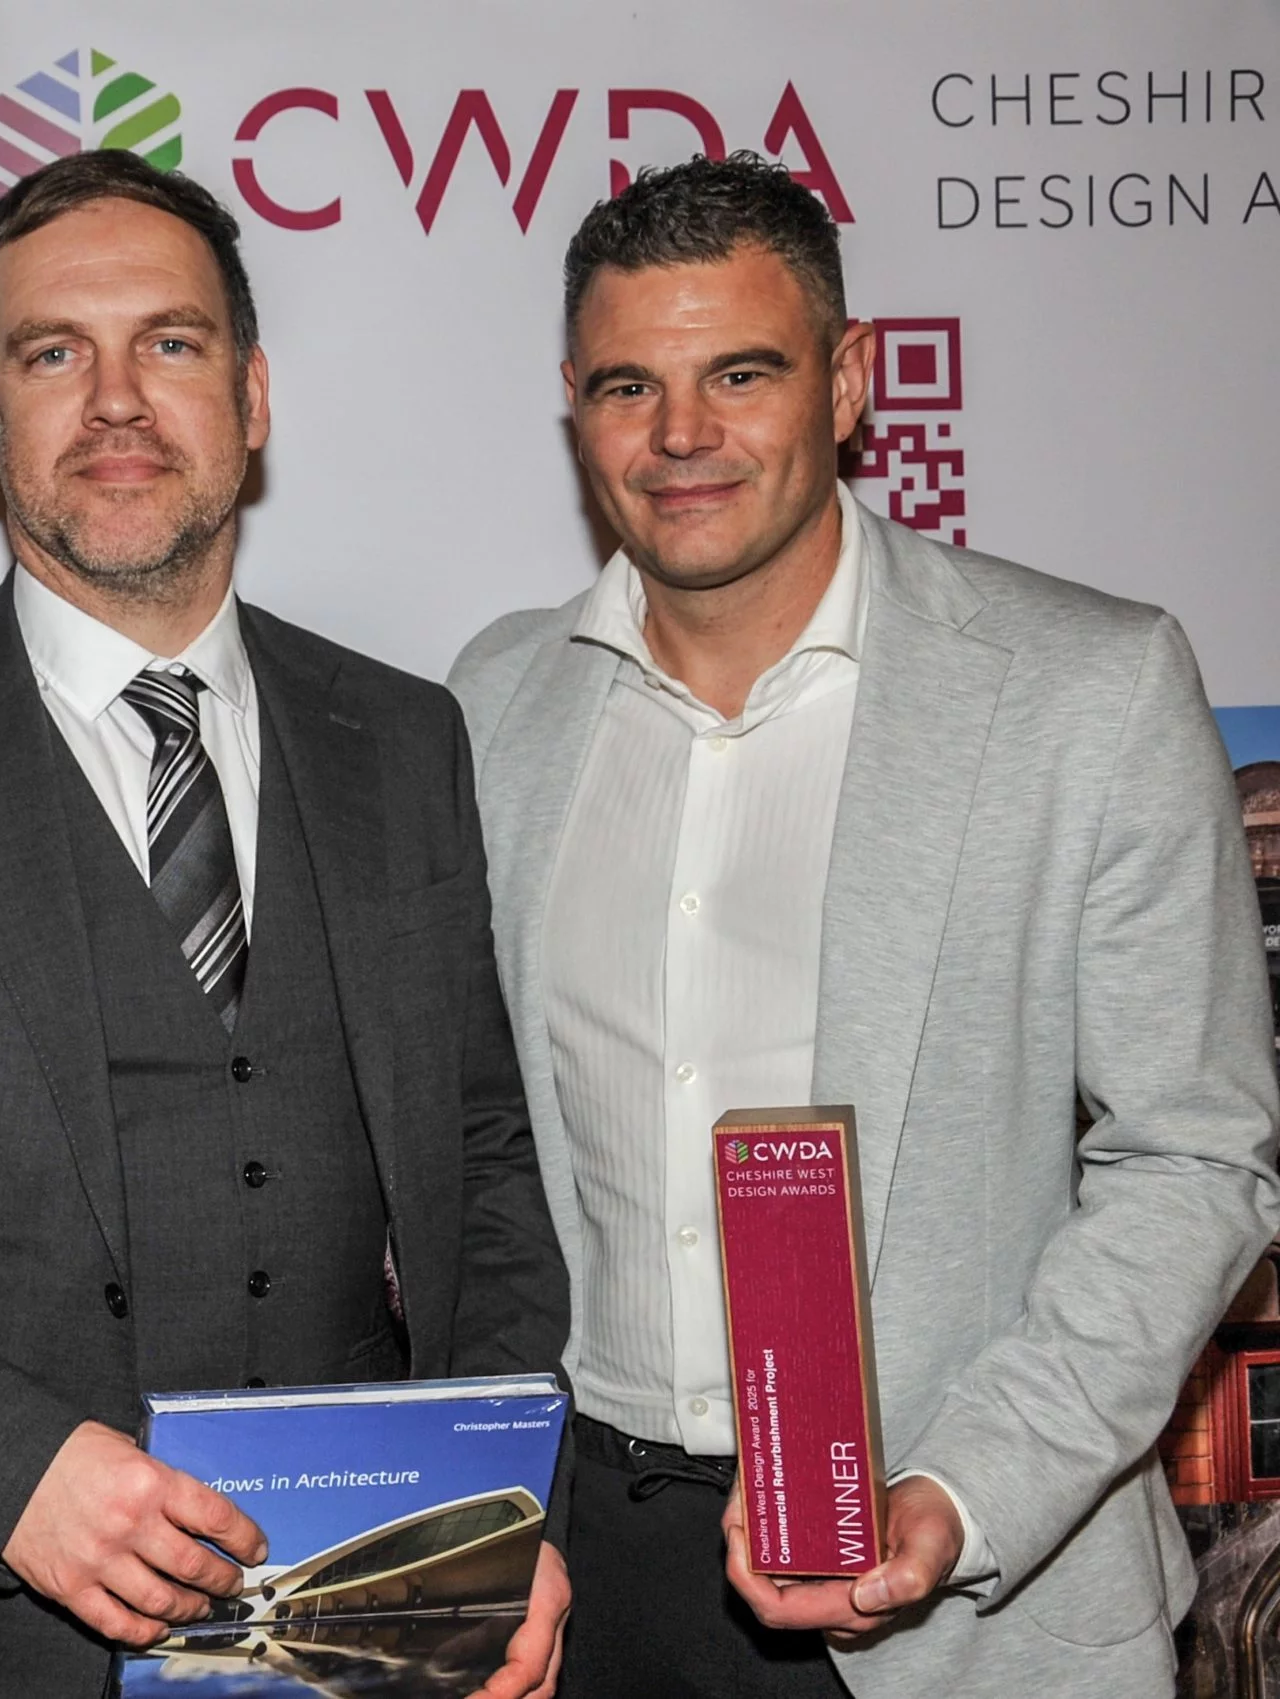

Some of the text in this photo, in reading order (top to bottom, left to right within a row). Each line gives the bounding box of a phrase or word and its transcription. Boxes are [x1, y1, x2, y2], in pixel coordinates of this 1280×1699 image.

[930, 69, 1265, 130] CHESHIR
[231, 79, 856, 236] CWDA
[936, 172, 1209, 230] DESIGN
[726, 1168, 835, 1182] CHESHIRE WEST
[753, 1141, 833, 1161] CWDA
[728, 1184, 836, 1197] DESIGN AWARDS
[453, 1420, 551, 1432] Christopher Masters
[203, 1470, 420, 1493] dows in Architecture
[746, 1369, 771, 1564] Cheshire West Design Award 2025 for
[763, 1348, 791, 1564] Commercial Refurbishment Project
[831, 1441, 865, 1566] WINNER
